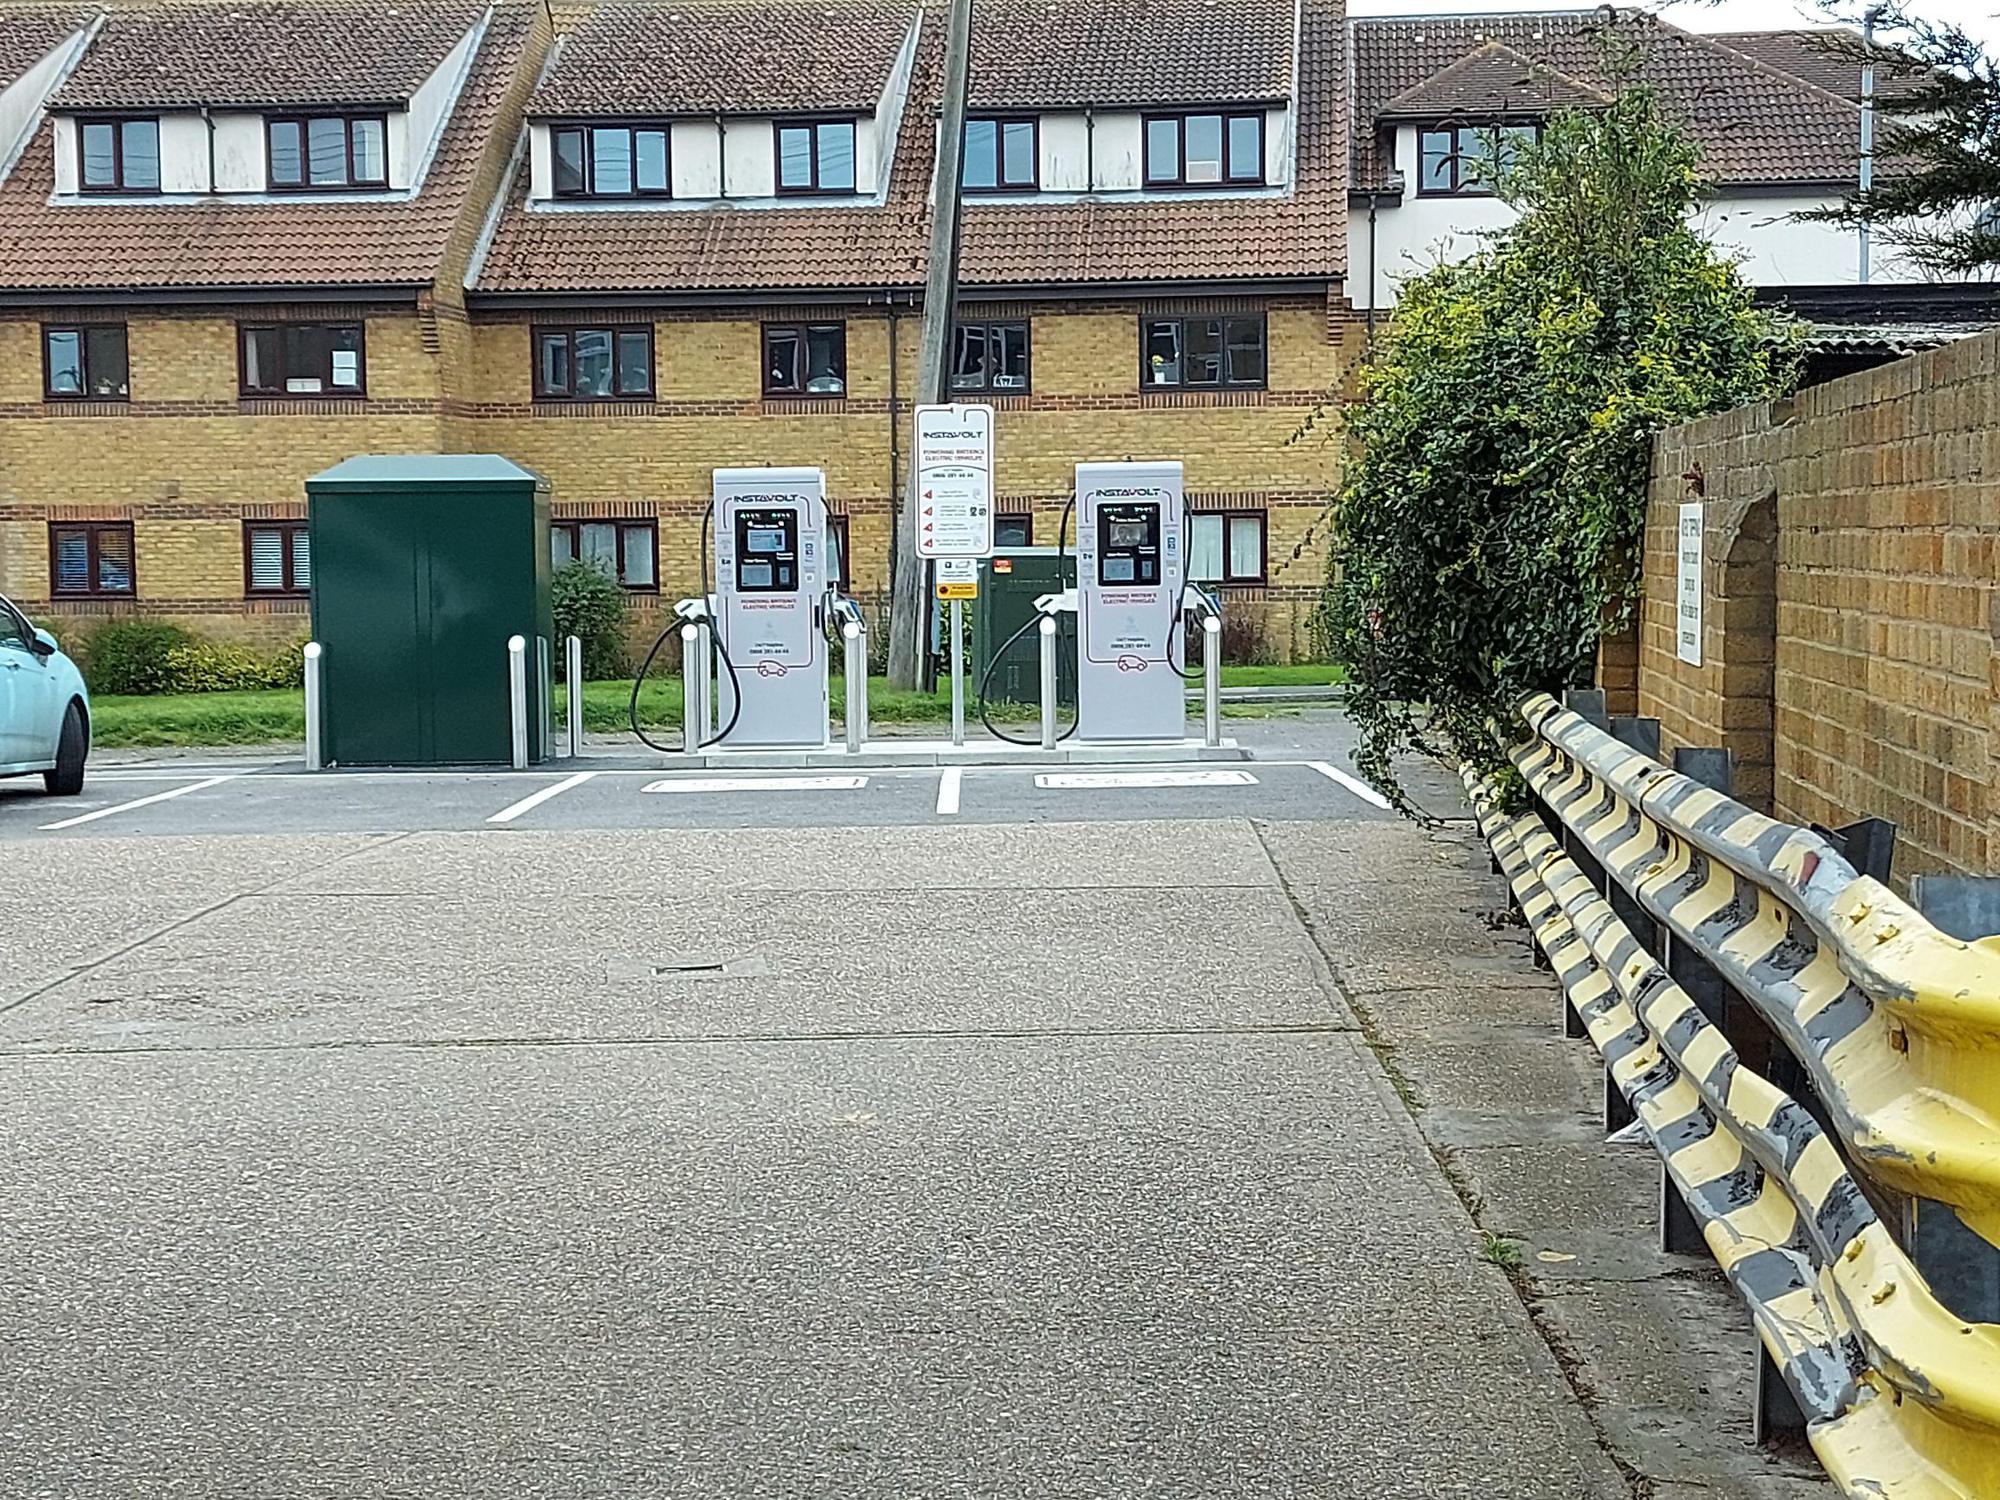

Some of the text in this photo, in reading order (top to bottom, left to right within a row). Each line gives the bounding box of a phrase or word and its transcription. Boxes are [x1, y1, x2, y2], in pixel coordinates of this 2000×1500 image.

[923, 431, 984, 439] INSTAVOLT
[1095, 488, 1161, 497] INSTAVOLT
[733, 494, 799, 503] INSTAVOLT
